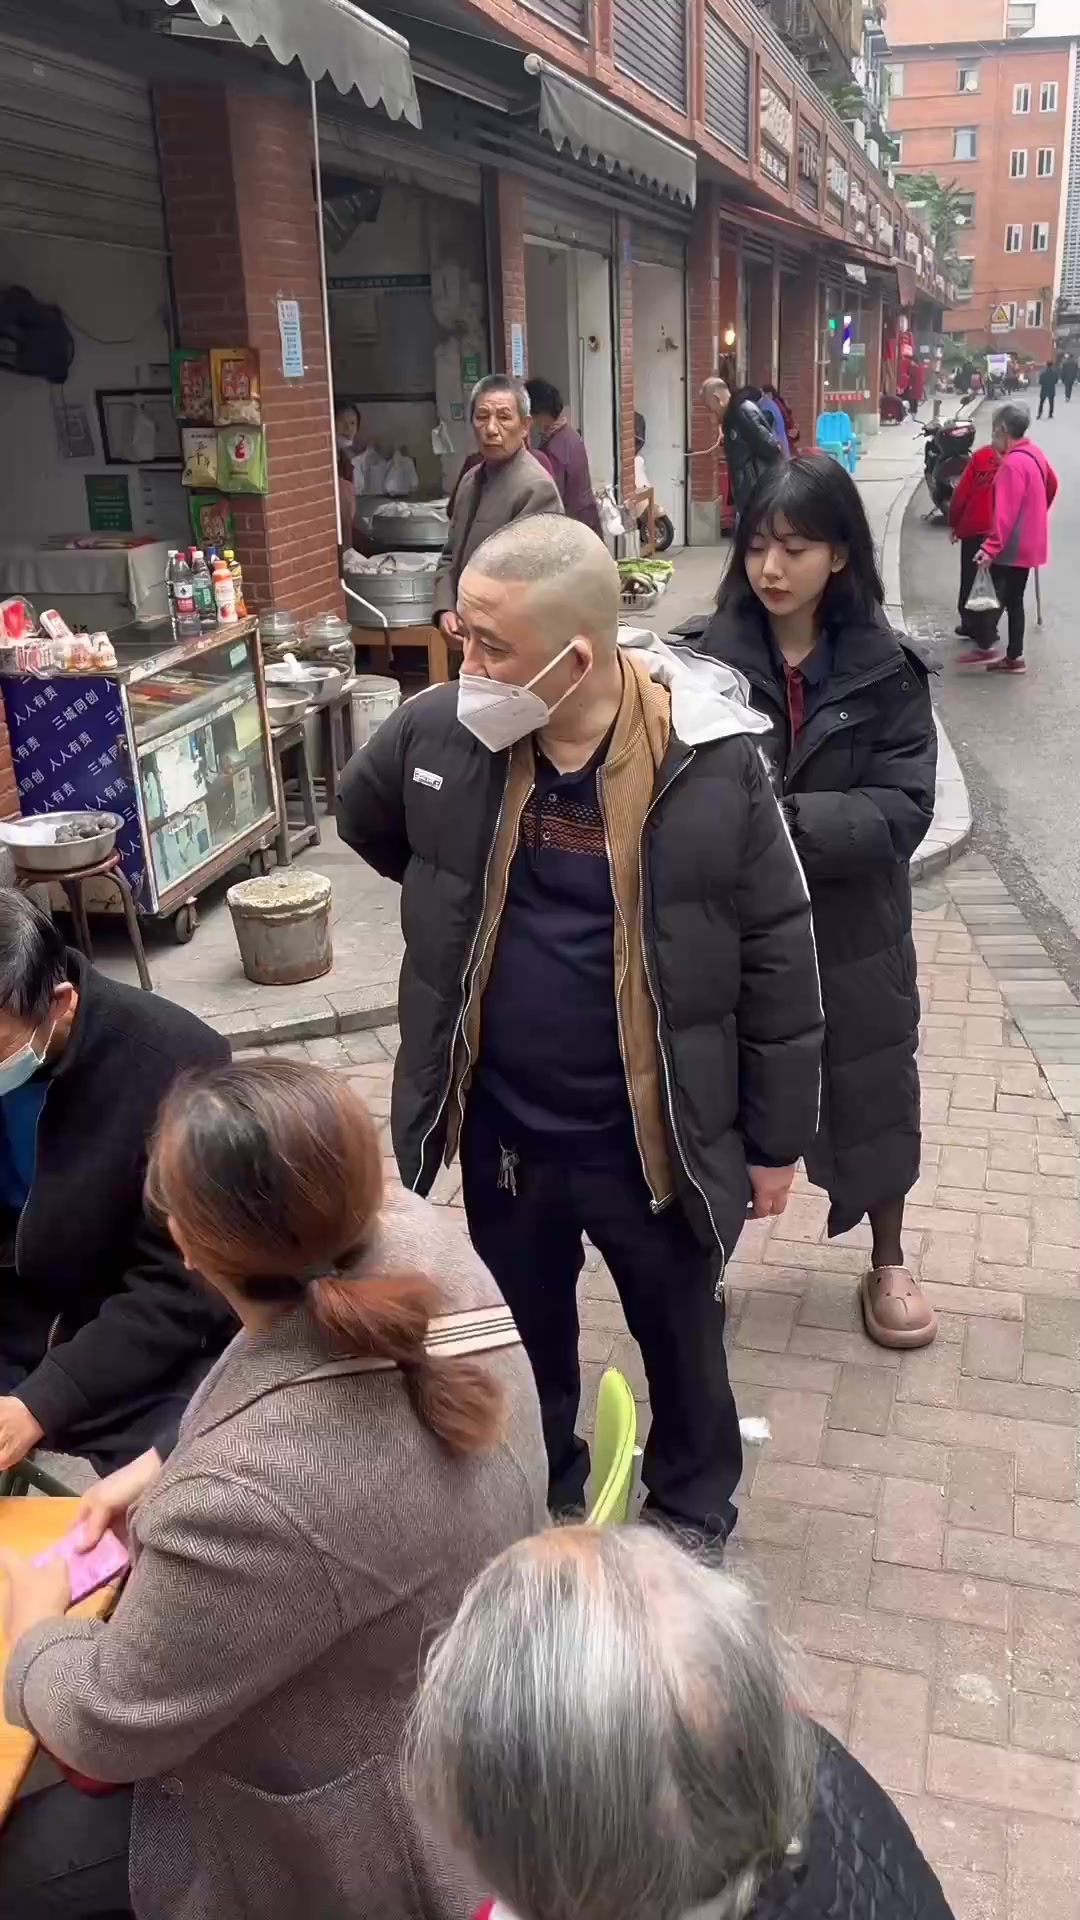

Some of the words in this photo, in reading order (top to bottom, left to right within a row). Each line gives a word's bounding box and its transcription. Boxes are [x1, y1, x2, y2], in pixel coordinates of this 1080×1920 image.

[13, 684, 58, 727] 人人有责
[52, 688, 99, 731] 三城同创
[49, 731, 93, 773] 人人有责
